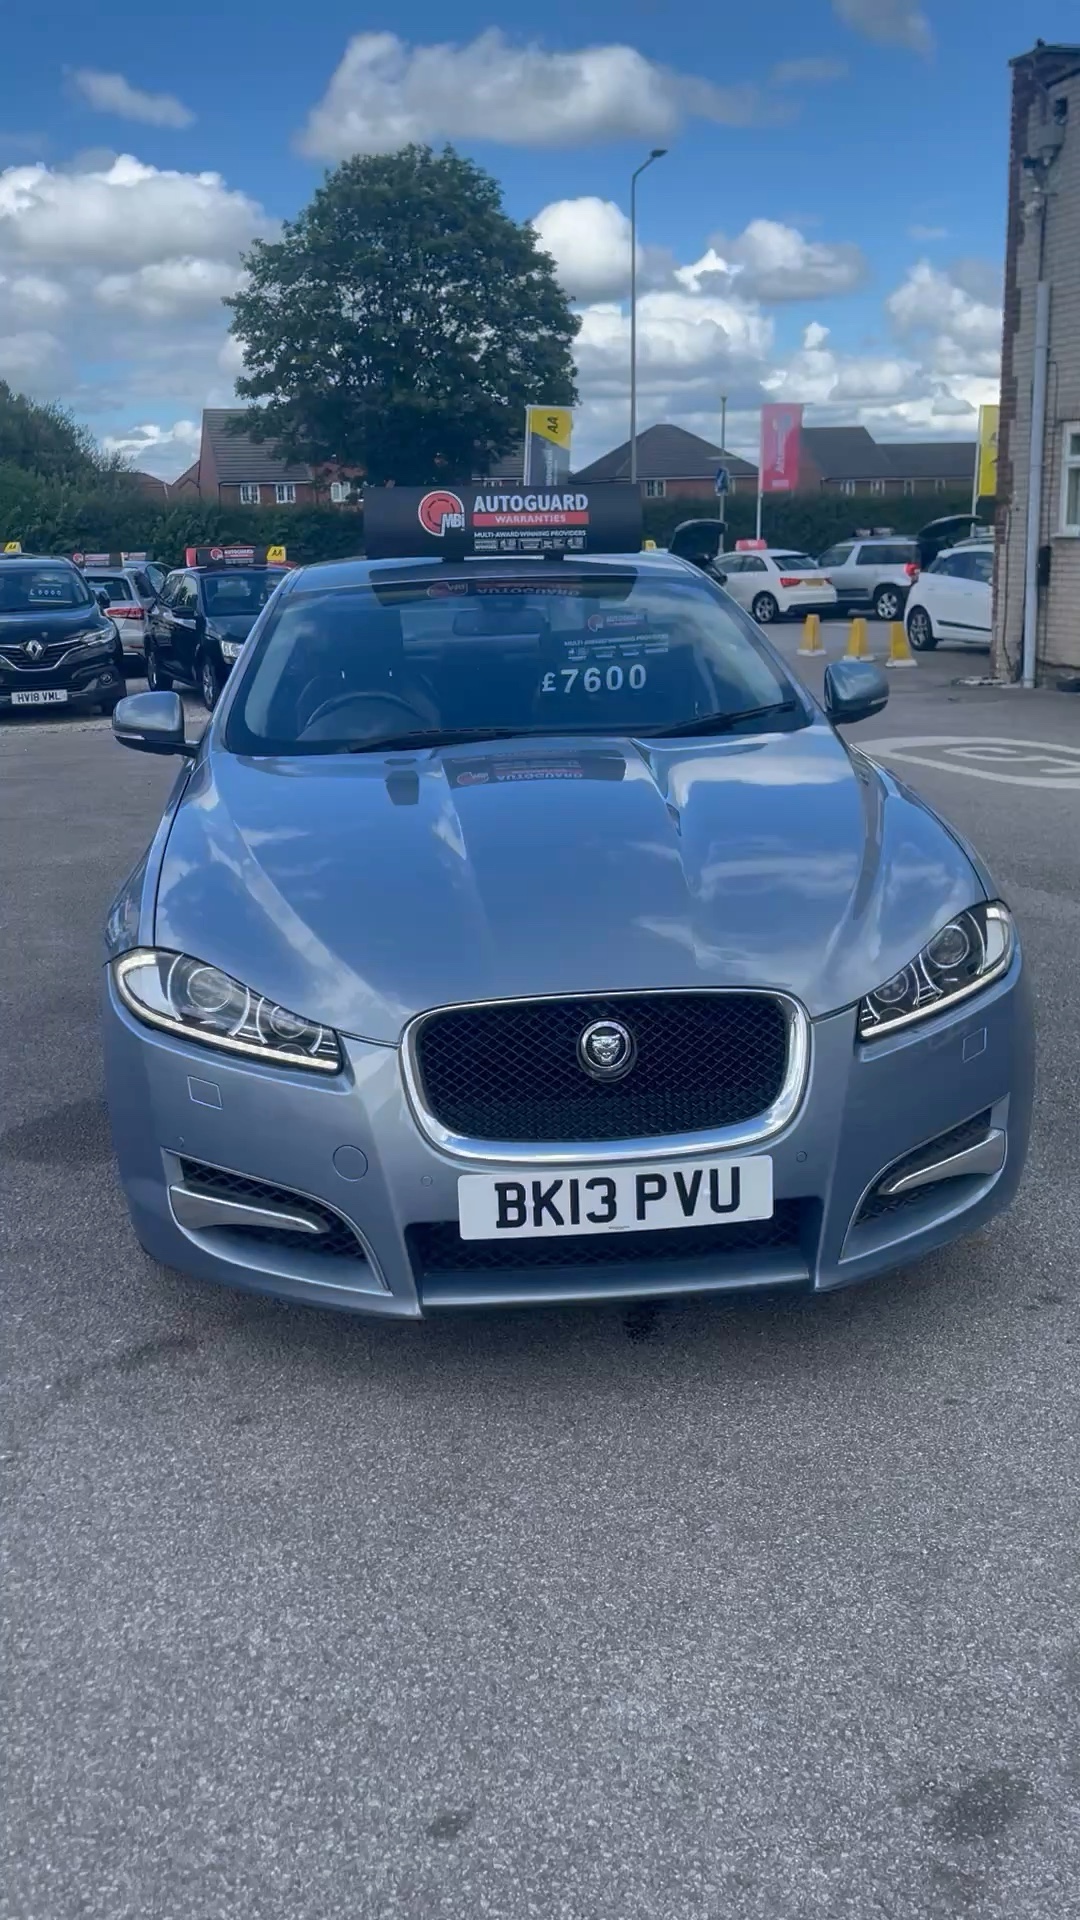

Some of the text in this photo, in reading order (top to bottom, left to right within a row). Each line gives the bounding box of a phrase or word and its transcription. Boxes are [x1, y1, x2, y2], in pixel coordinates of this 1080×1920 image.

[547, 416, 559, 434] AA
[473, 493, 589, 513] AUTOGUARD
[495, 514, 566, 524] WARRANTIES
[550, 529, 587, 537] PROVIDERS
[271, 549, 283, 557] AA
[541, 663, 647, 694] £7600
[17, 690, 62, 703] HV18 VML
[493, 1166, 741, 1229] BK13 PVU
